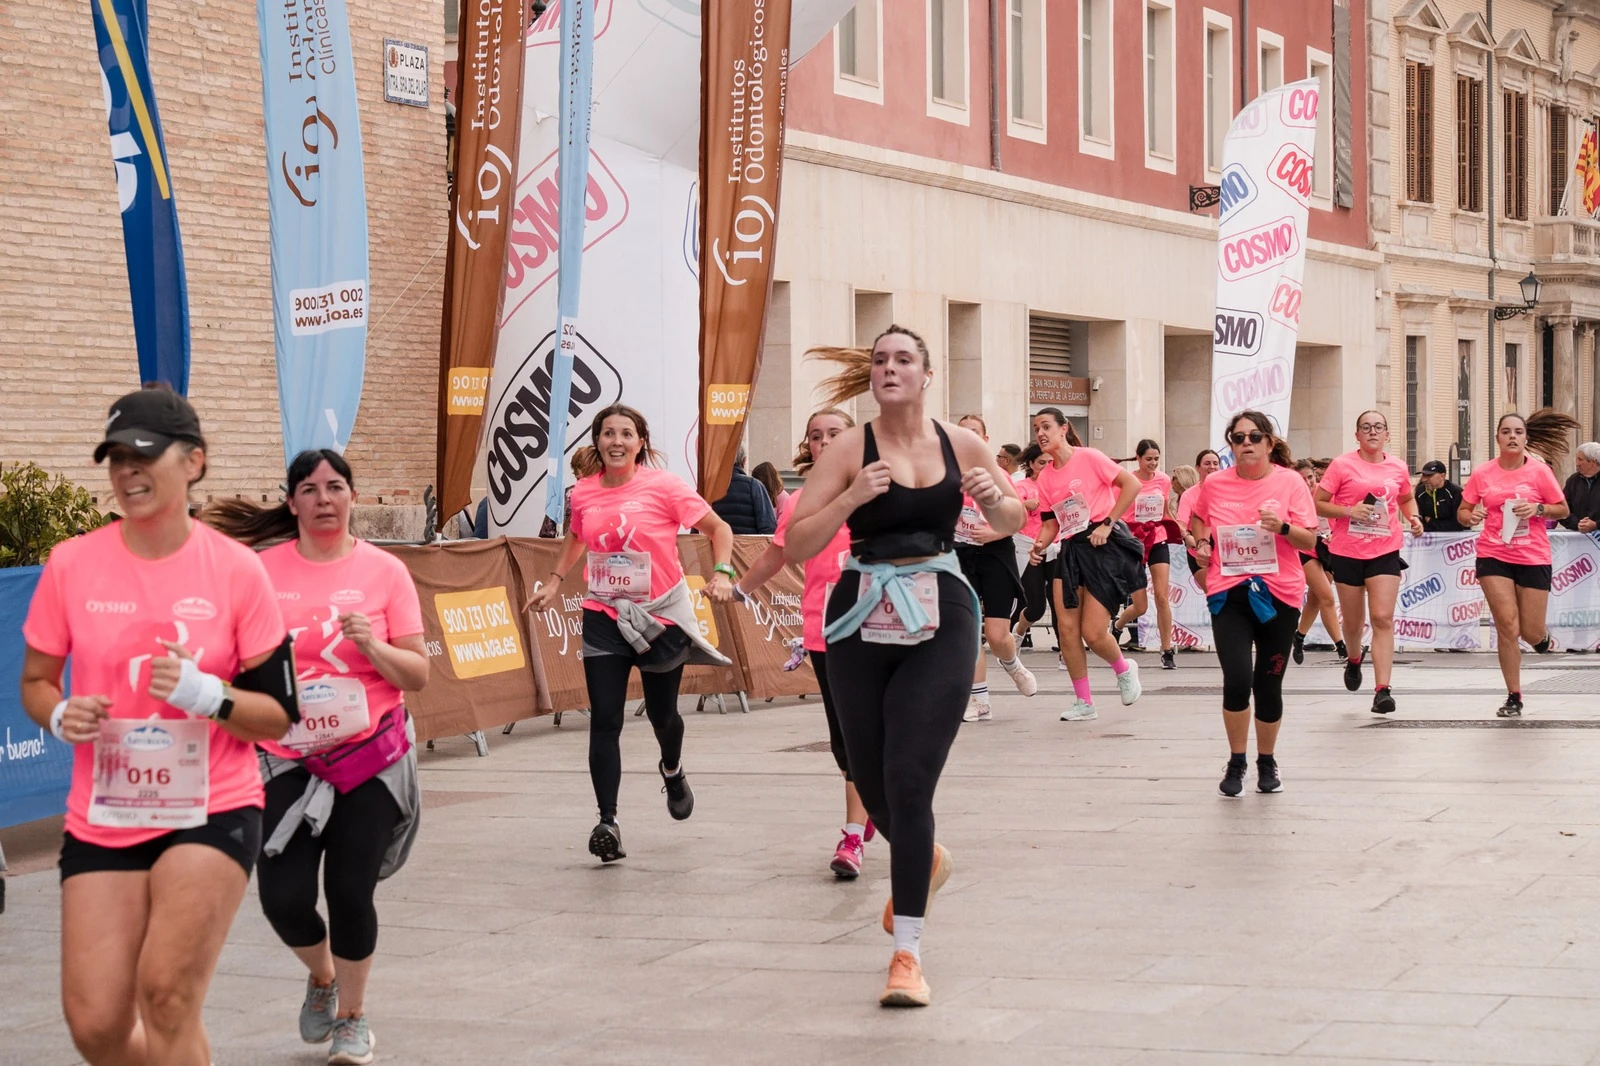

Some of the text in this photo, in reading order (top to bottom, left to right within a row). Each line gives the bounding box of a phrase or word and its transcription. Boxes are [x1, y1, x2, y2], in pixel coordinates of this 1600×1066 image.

[400, 53, 425, 70] PLAZA
[1289, 89, 1318, 120] CO
[728, 59, 746, 184] Institutos
[1224, 223, 1292, 273] COSMO
[295, 297, 316, 311] 900
[340, 288, 363, 303] 002
[295, 308, 363, 327] www.ioa.es
[711, 391, 735, 404] 900
[1222, 363, 1285, 412] COSMO
[488, 348, 602, 505] COSMO
[1237, 546, 1258, 556] 016
[608, 575, 631, 586] 016
[1551, 557, 1592, 591] COSMO
[1400, 577, 1441, 608] COSMO
[85, 599, 137, 614] OYSHO
[443, 608, 468, 633] 900
[485, 600, 510, 627] 002
[1394, 619, 1433, 639] COSMO
[306, 714, 339, 731] 016
[6, 726, 45, 760] bueno!
[127, 767, 171, 785] 016
